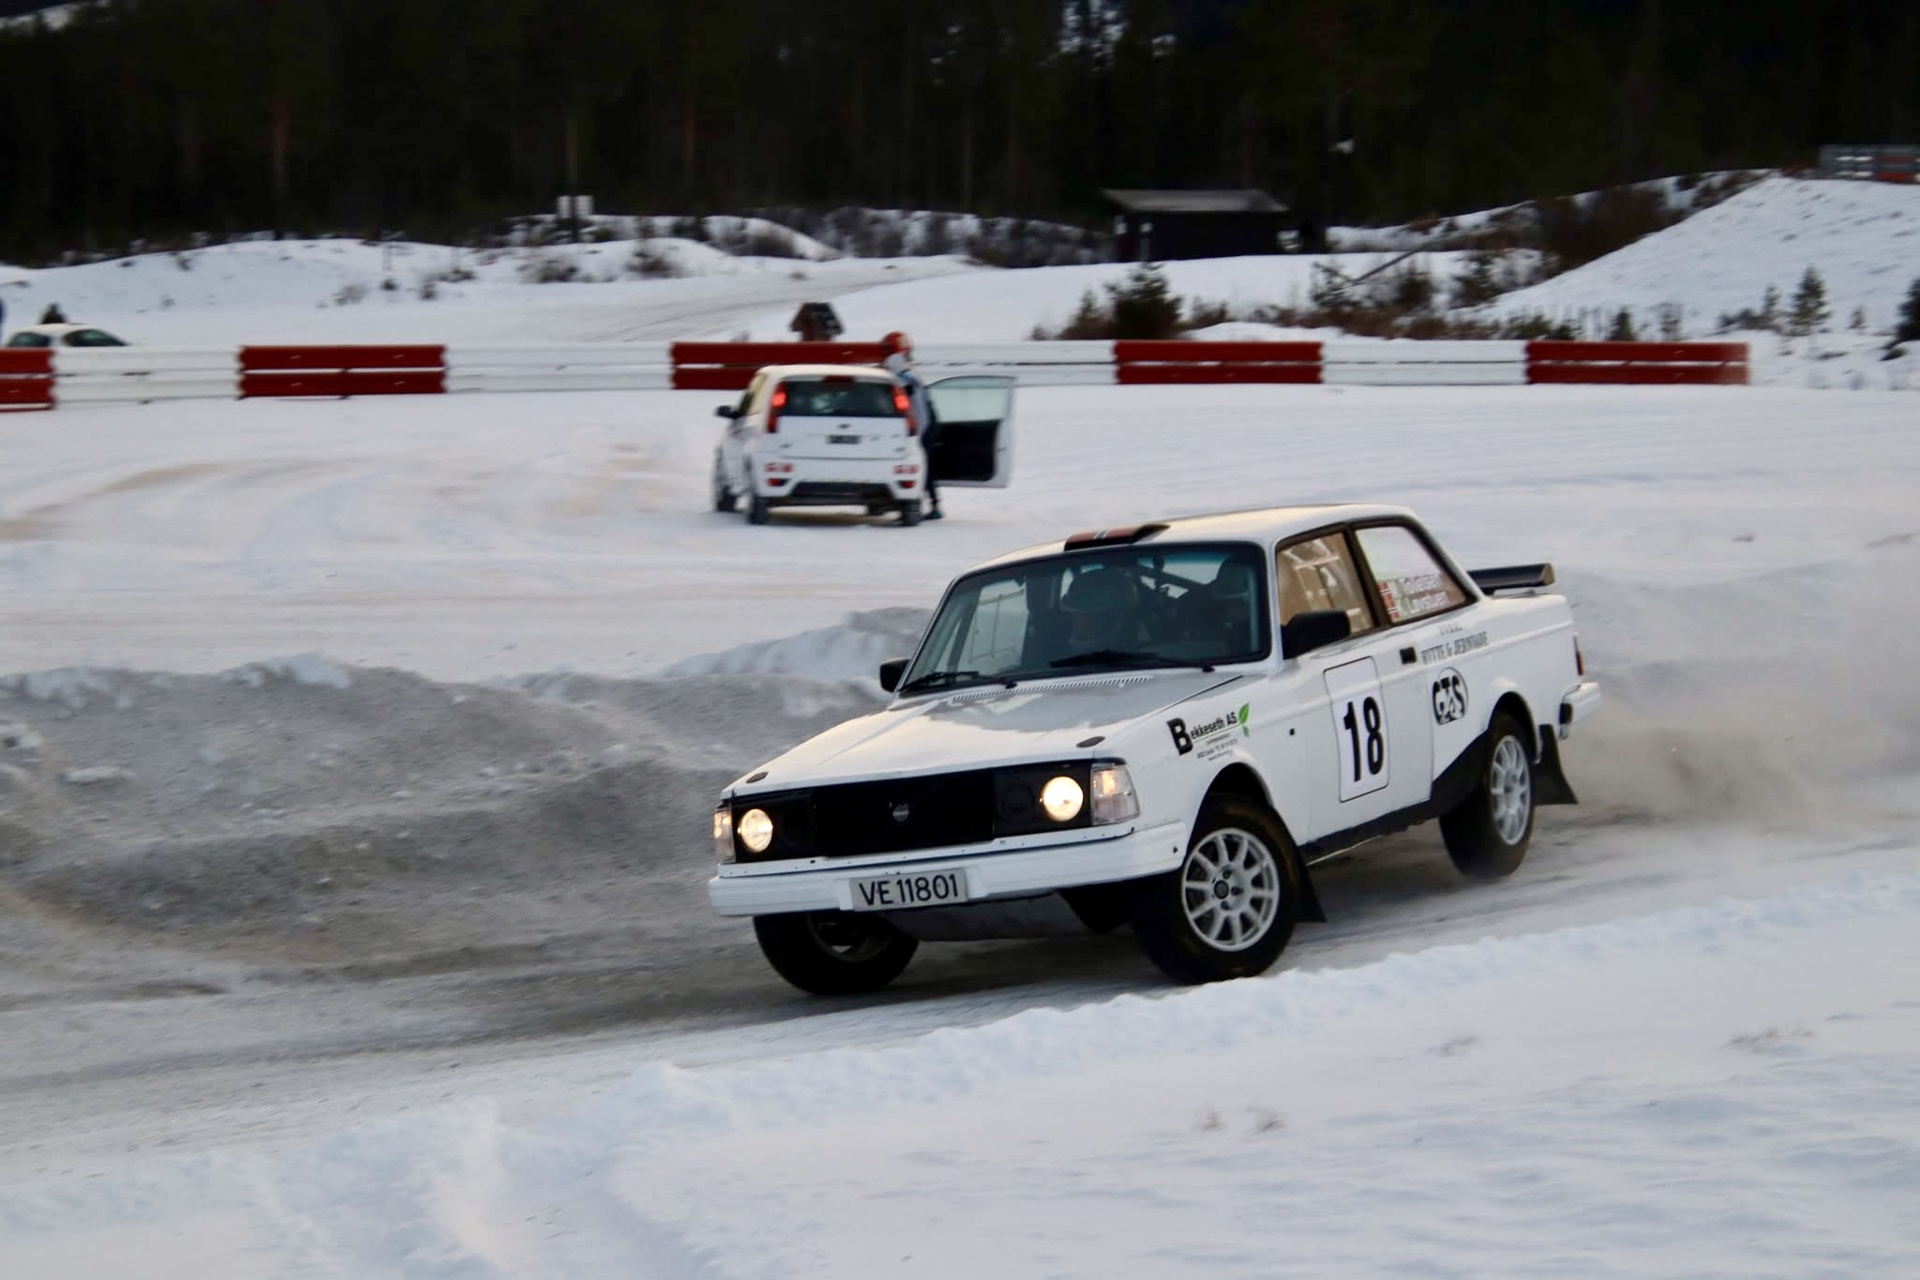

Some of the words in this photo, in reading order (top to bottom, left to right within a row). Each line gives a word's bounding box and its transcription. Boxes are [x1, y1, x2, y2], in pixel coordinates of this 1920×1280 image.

[1166, 717, 1225, 755] Bekkeseth
[1226, 711, 1238, 726] AS
[1343, 696, 1384, 782] 18
